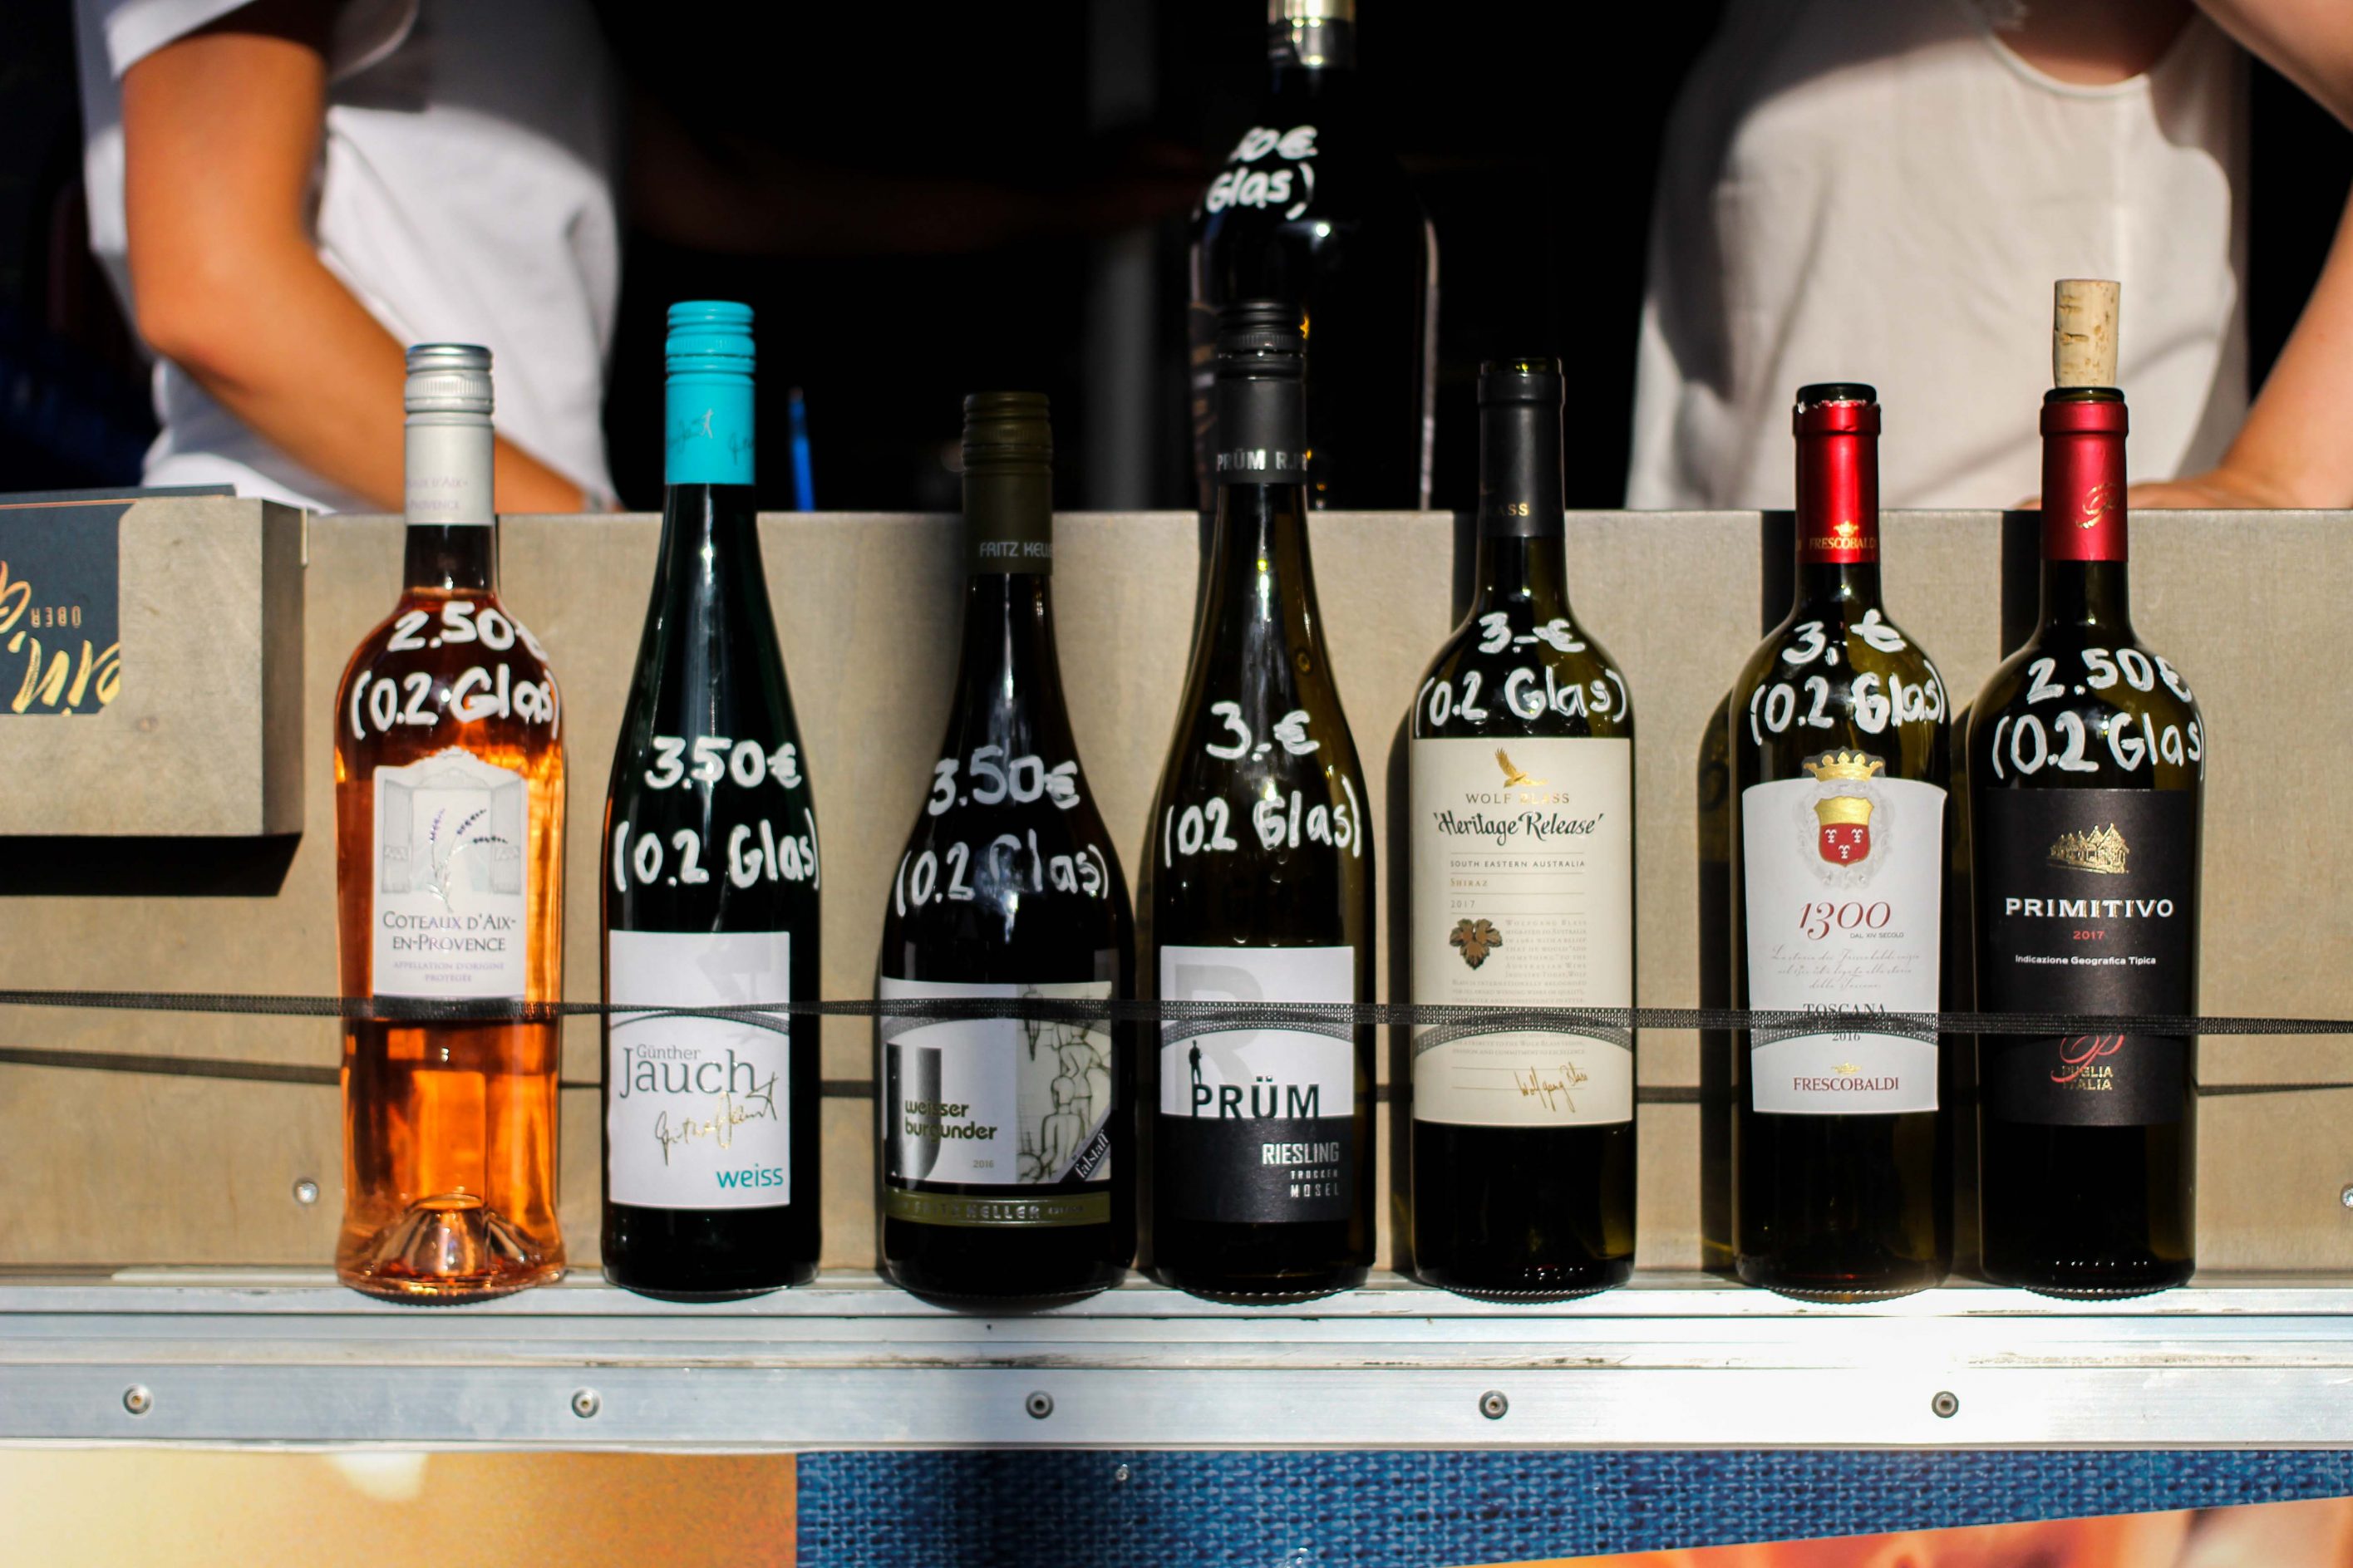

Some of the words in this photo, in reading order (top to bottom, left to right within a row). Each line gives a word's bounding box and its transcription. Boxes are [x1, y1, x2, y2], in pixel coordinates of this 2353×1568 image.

[980, 541, 1019, 558] FRITZ
[2026, 647, 2193, 705] 2.50€
[351, 671, 439, 740] (0.2
[1504, 665, 1627, 723] Glas)
[1750, 675, 1834, 746] (0.2
[1850, 659, 1945, 735] Glas)
[1992, 710, 2099, 779] (0.2
[644, 735, 802, 789] 3.50€
[928, 745, 1081, 816] 3.50€
[1465, 793, 1513, 804] WOLF
[1253, 774, 1361, 859] Glas)
[613, 820, 709, 892] (0.2
[727, 808, 820, 891] Glas)
[896, 841, 976, 917] (0.2
[1450, 900, 1476, 909] 2017
[2005, 897, 2175, 918] PRIMITIVO
[383, 911, 462, 929] COTEAUX
[1799, 901, 1892, 941] 1300
[2073, 931, 2105, 940] 2017
[2015, 956, 2068, 964] Indicazione
[2070, 956, 2126, 965] Geografica
[2129, 956, 2156, 965] Tipica
[1832, 1030, 1860, 1041] 2016
[637, 1044, 701, 1059] Günther
[620, 1047, 756, 1099] Jauch
[1794, 1077, 1898, 1090] FRESCOBALDI
[905, 1099, 969, 1118] weisser
[1191, 1076, 1319, 1118] PRÜM
[905, 1121, 997, 1143] burgunder
[972, 1159, 994, 1168] 2016
[1075, 1128, 1109, 1178] falstaff
[1263, 1142, 1340, 1165] RIESLING
[716, 1163, 783, 1188] weiss
[1290, 1182, 1339, 1197] MOSEL
[967, 1205, 1040, 1219] KELLER
